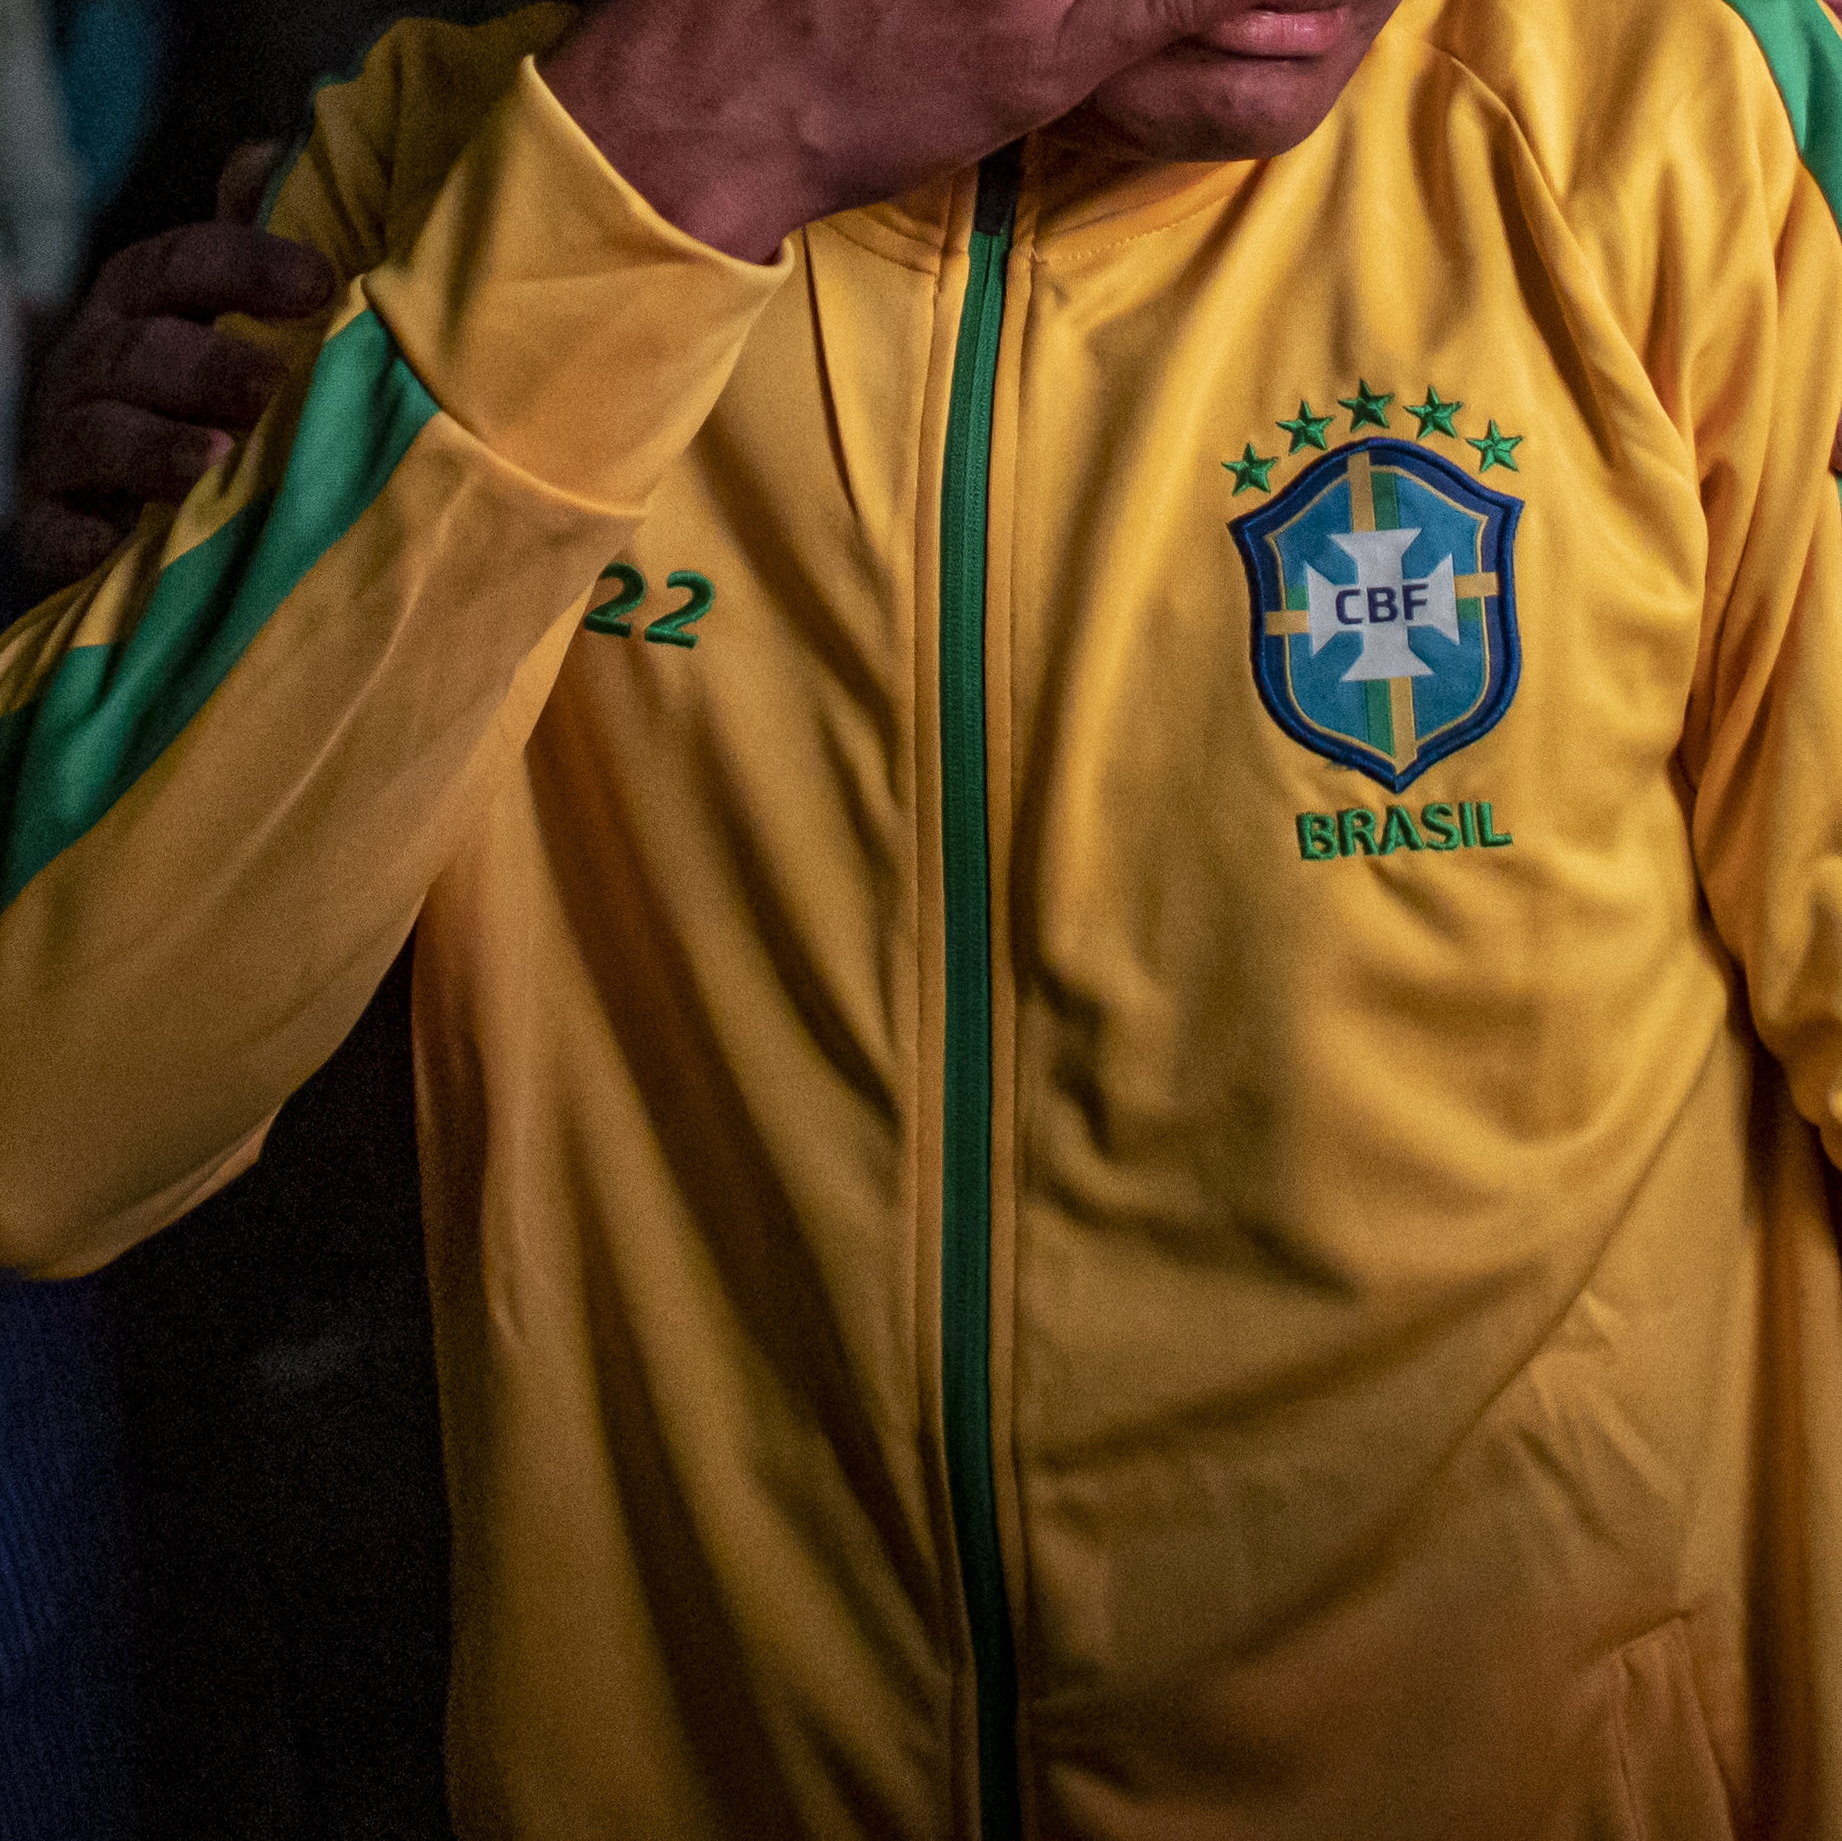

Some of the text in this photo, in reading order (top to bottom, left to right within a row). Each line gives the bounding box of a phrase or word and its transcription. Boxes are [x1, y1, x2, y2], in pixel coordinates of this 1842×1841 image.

[583, 561, 716, 649] 22
[1334, 583, 1430, 625] CBF
[1296, 801, 1513, 860] BRASIL
